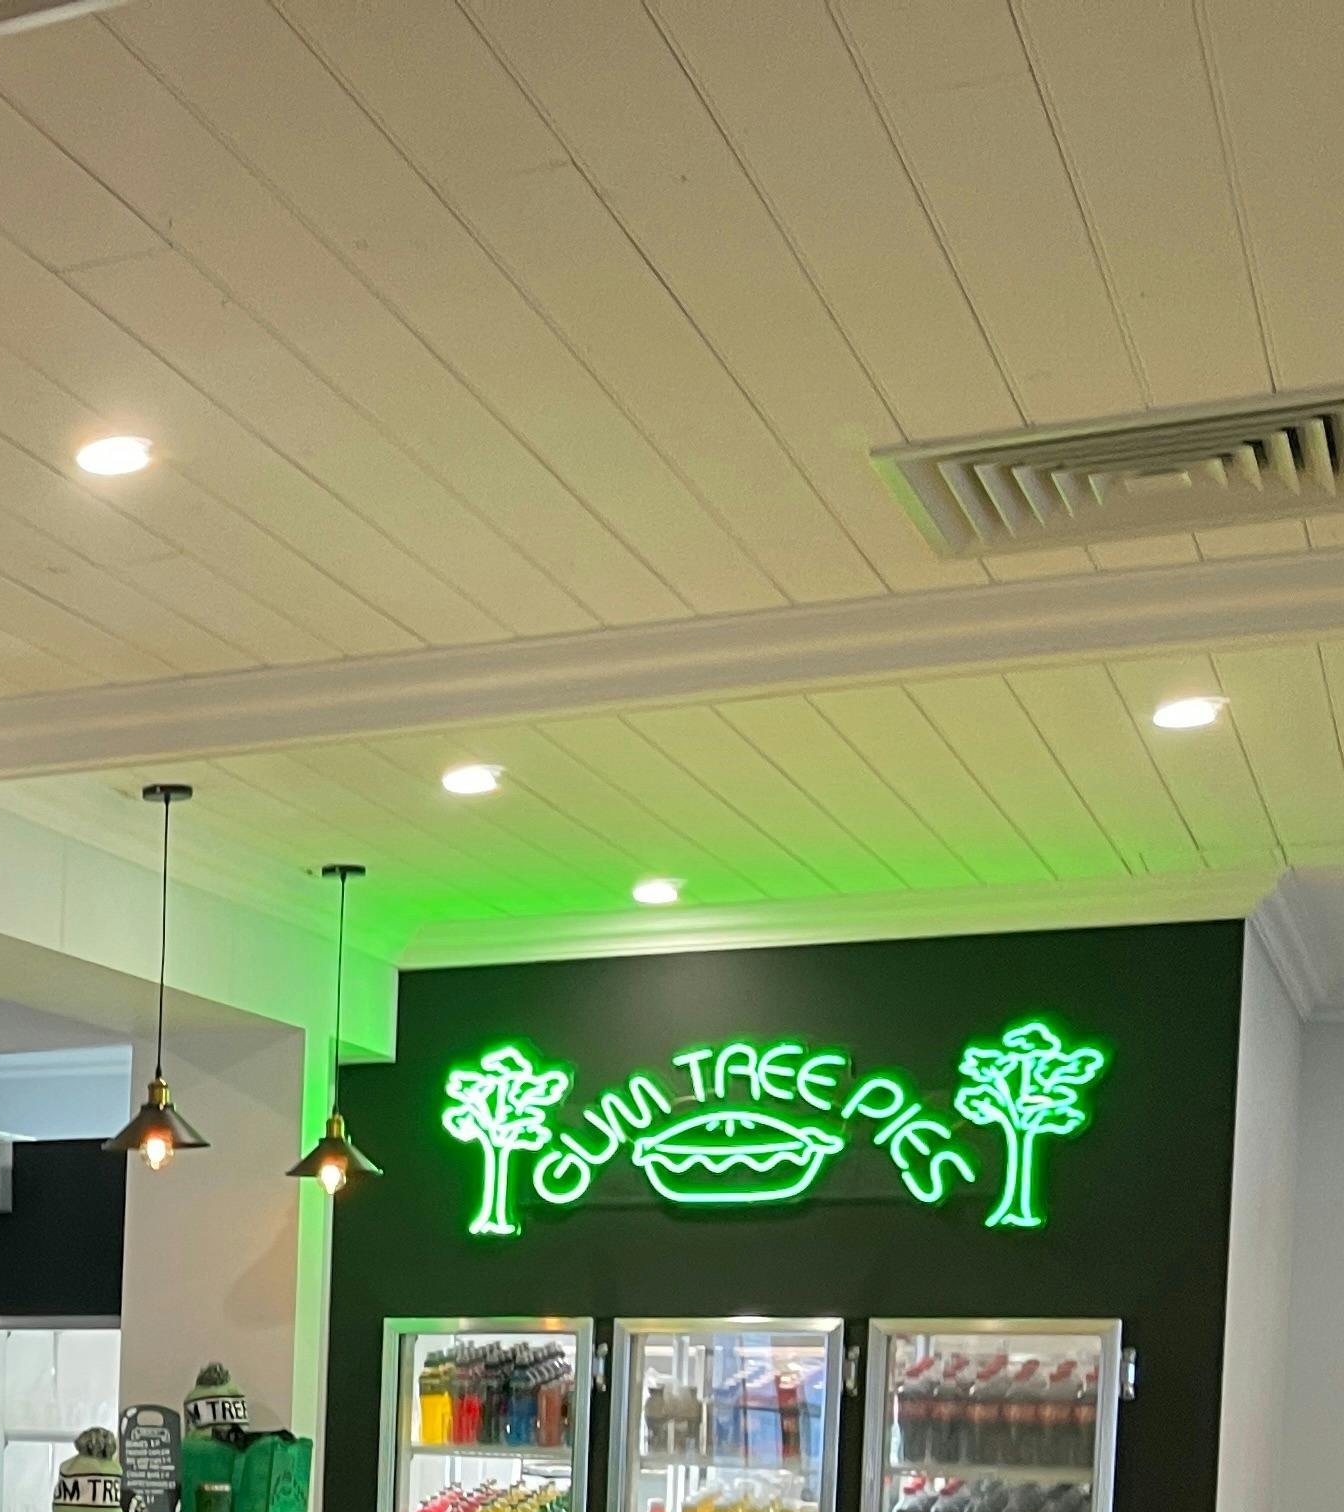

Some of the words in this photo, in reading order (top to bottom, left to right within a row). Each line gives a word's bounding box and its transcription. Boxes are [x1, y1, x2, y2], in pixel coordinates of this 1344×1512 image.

[533, 1073, 673, 1204] GUM
[673, 1044, 848, 1111] TREE
[840, 1074, 975, 1203] PIES
[54, 1479, 80, 1502] UM
[88, 1479, 121, 1502] TRE
